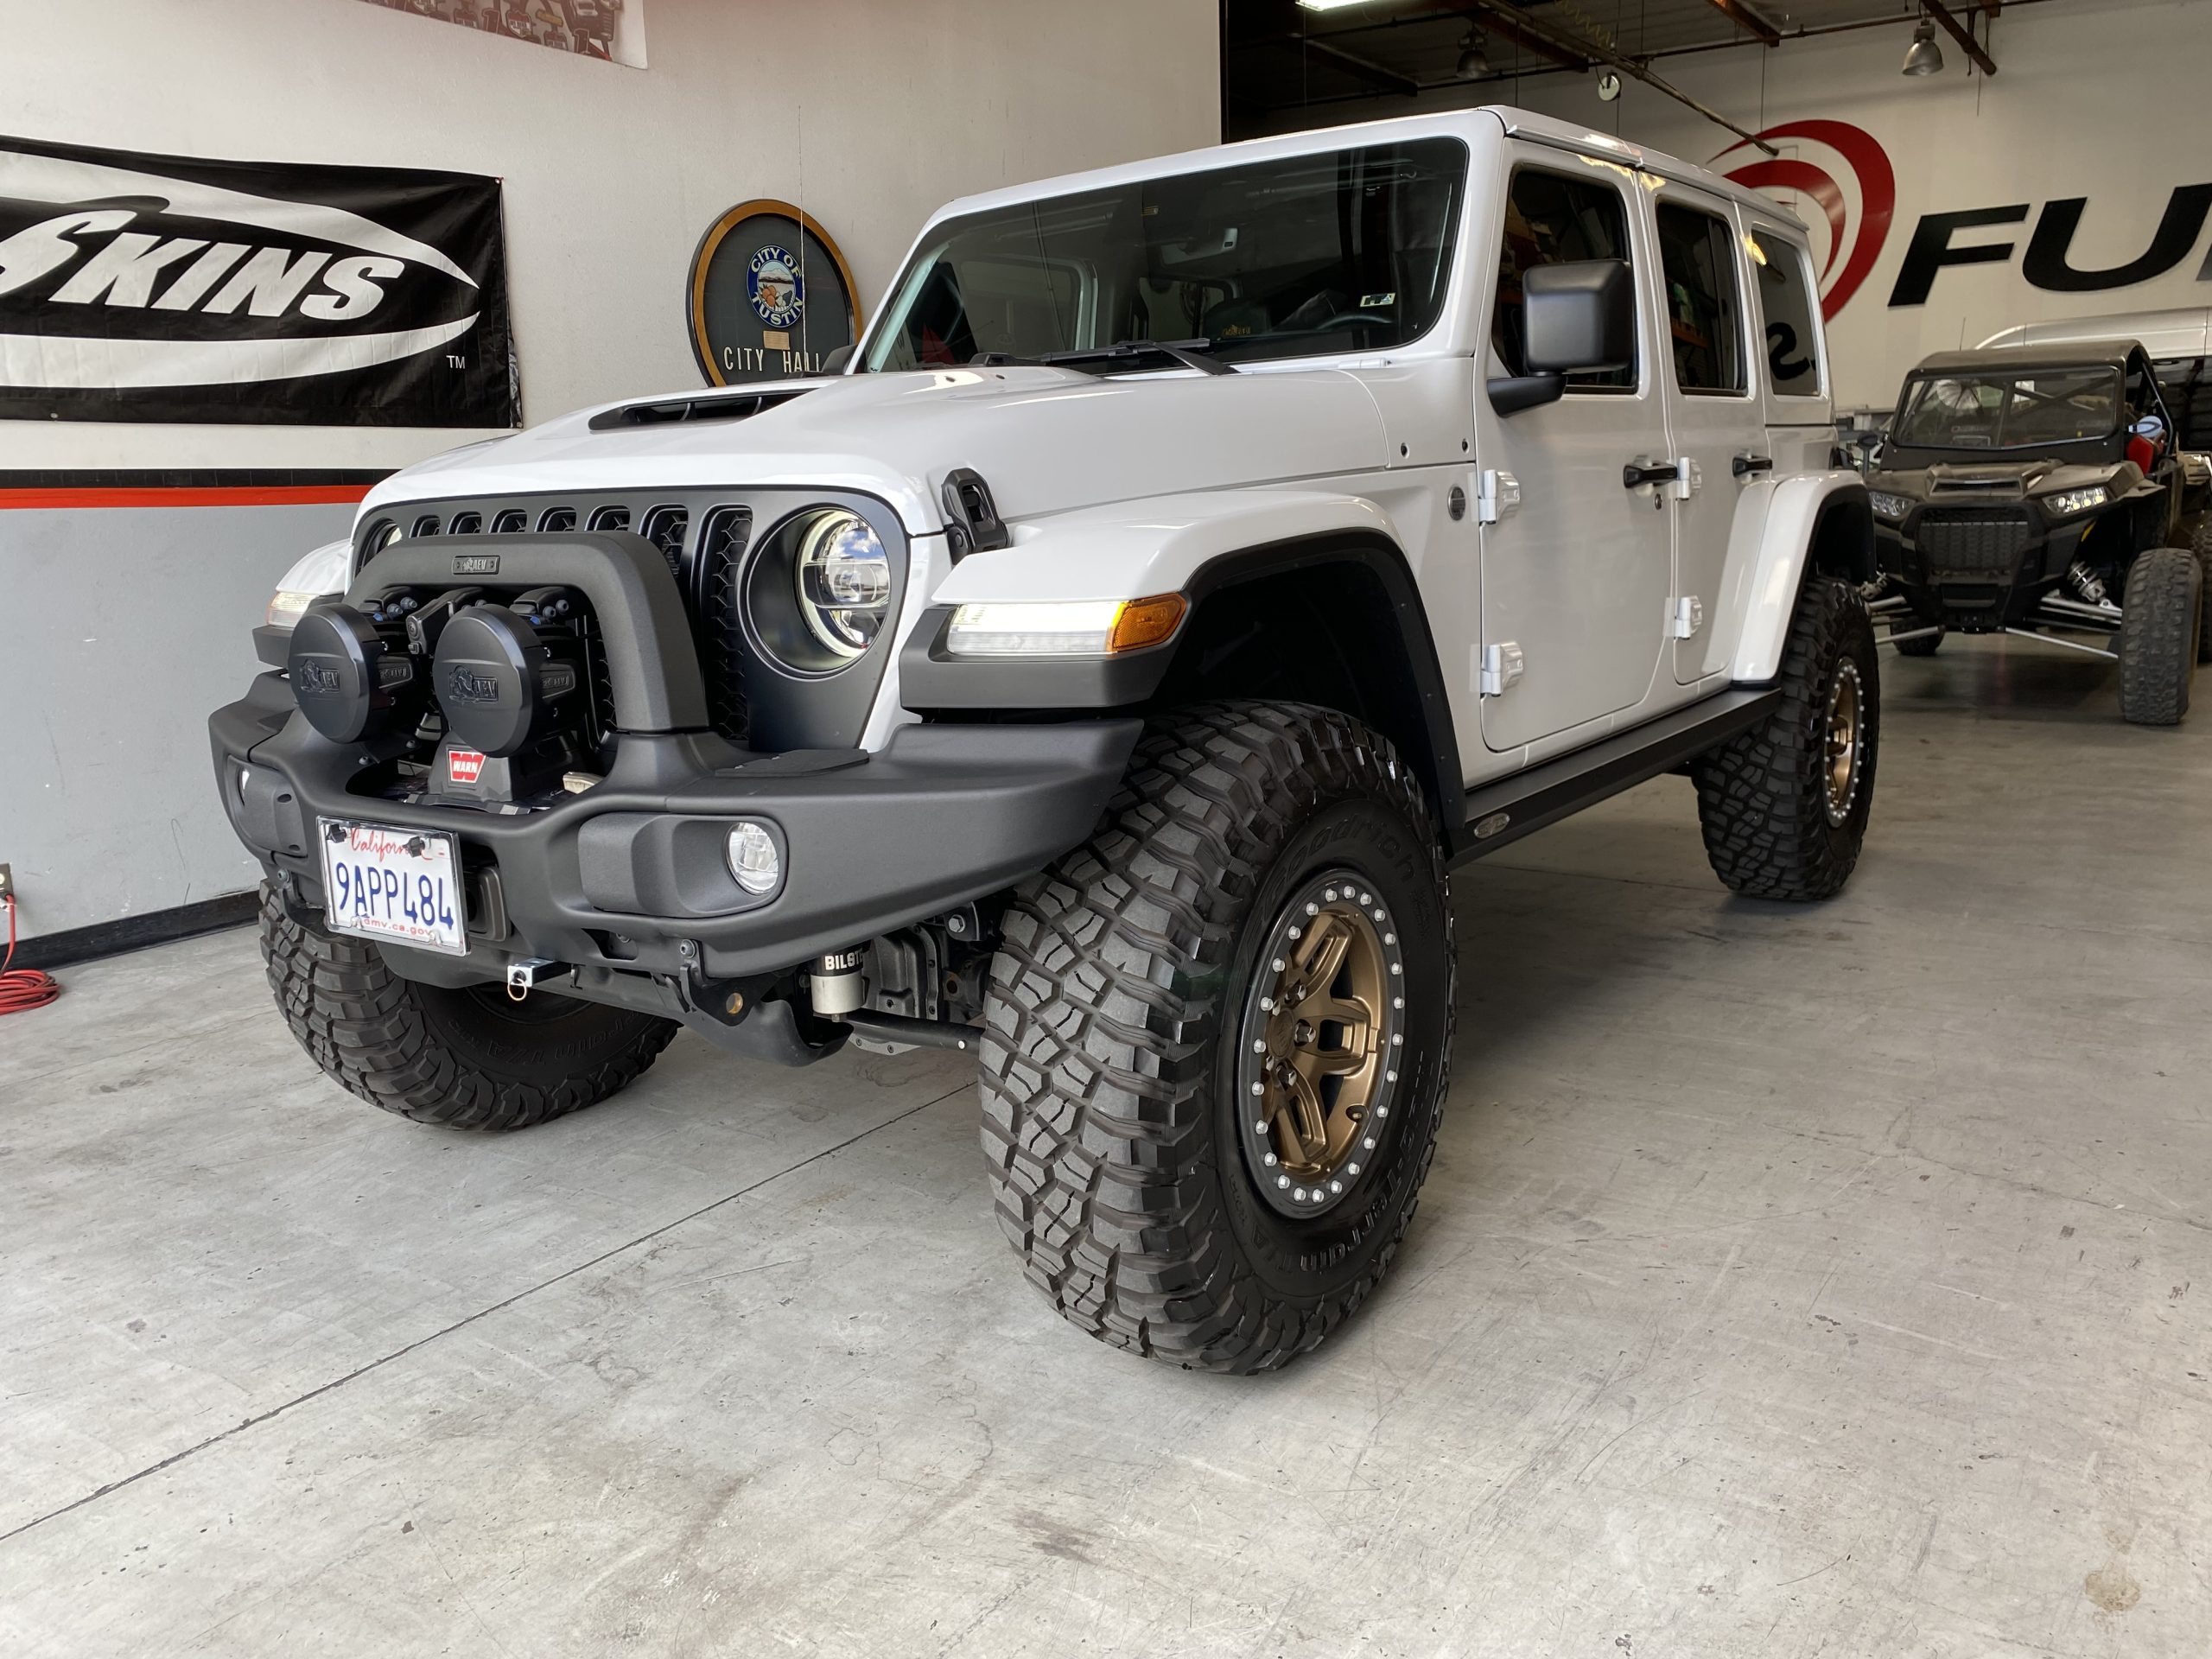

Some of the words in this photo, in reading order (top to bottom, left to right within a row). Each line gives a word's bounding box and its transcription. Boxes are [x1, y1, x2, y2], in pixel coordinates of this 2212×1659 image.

[1887, 183, 2212, 307] FU
[751, 247, 780, 273] CITY
[783, 254, 803, 278] OF
[752, 291, 804, 326] TUSTIN
[447, 355, 466, 369] TM
[724, 346, 764, 372] CITY
[453, 760, 478, 773] WARN
[336, 862, 454, 930] 9APP484
